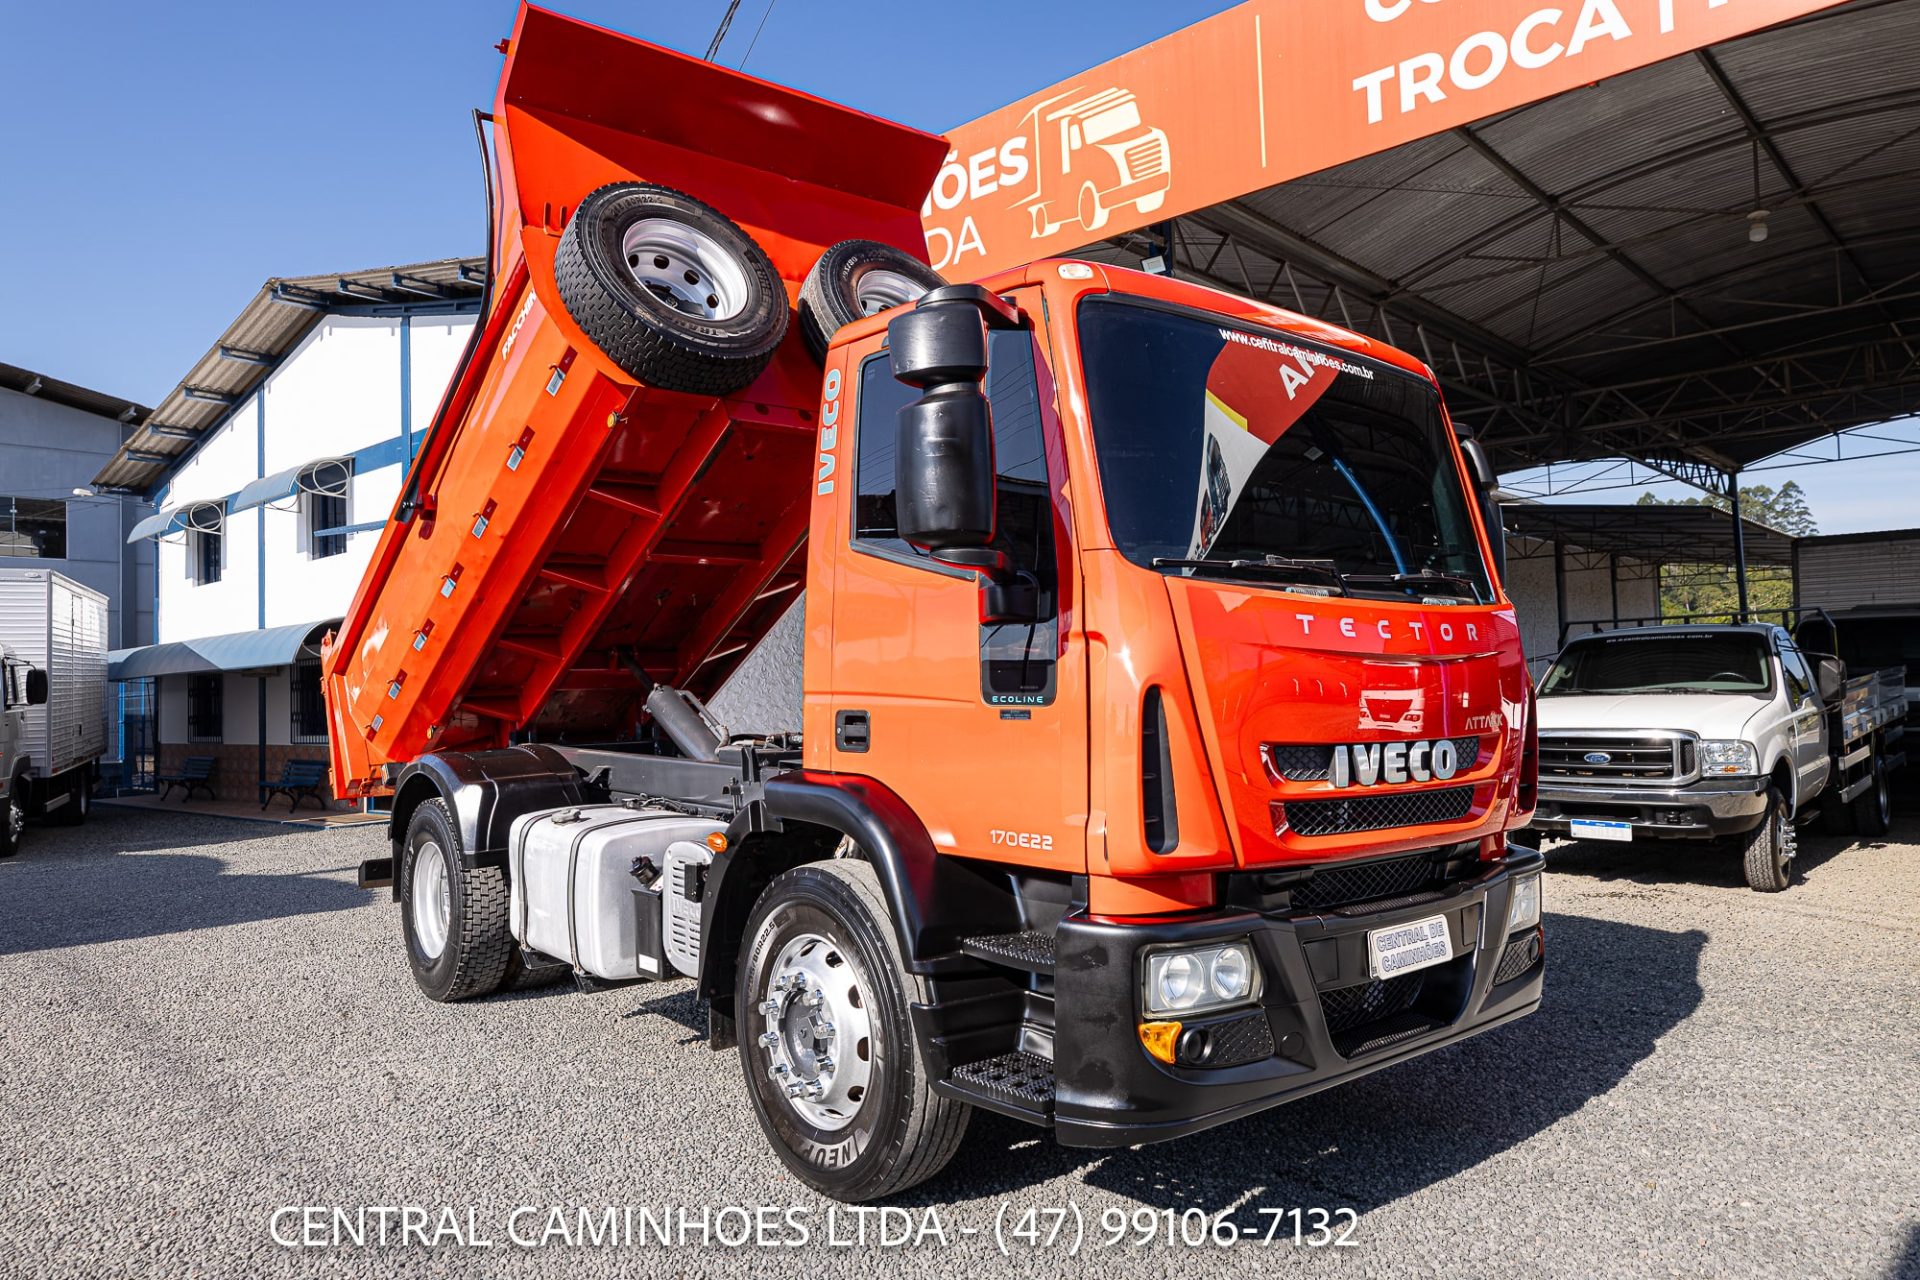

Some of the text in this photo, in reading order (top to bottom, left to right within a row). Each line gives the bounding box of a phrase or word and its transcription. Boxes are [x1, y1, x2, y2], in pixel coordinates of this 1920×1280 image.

[1353, 0, 1632, 125] TROCA
[818, 369, 841, 496] IVECO
[1296, 614, 1478, 641] TECTOR
[992, 695, 1044, 703] ECOLINE
[1334, 740, 1457, 788] IVECO
[991, 829, 1053, 851] 170E22
[1377, 922, 1444, 952] CENTRAL DE
[1382, 941, 1447, 972] CAMINHÕES
